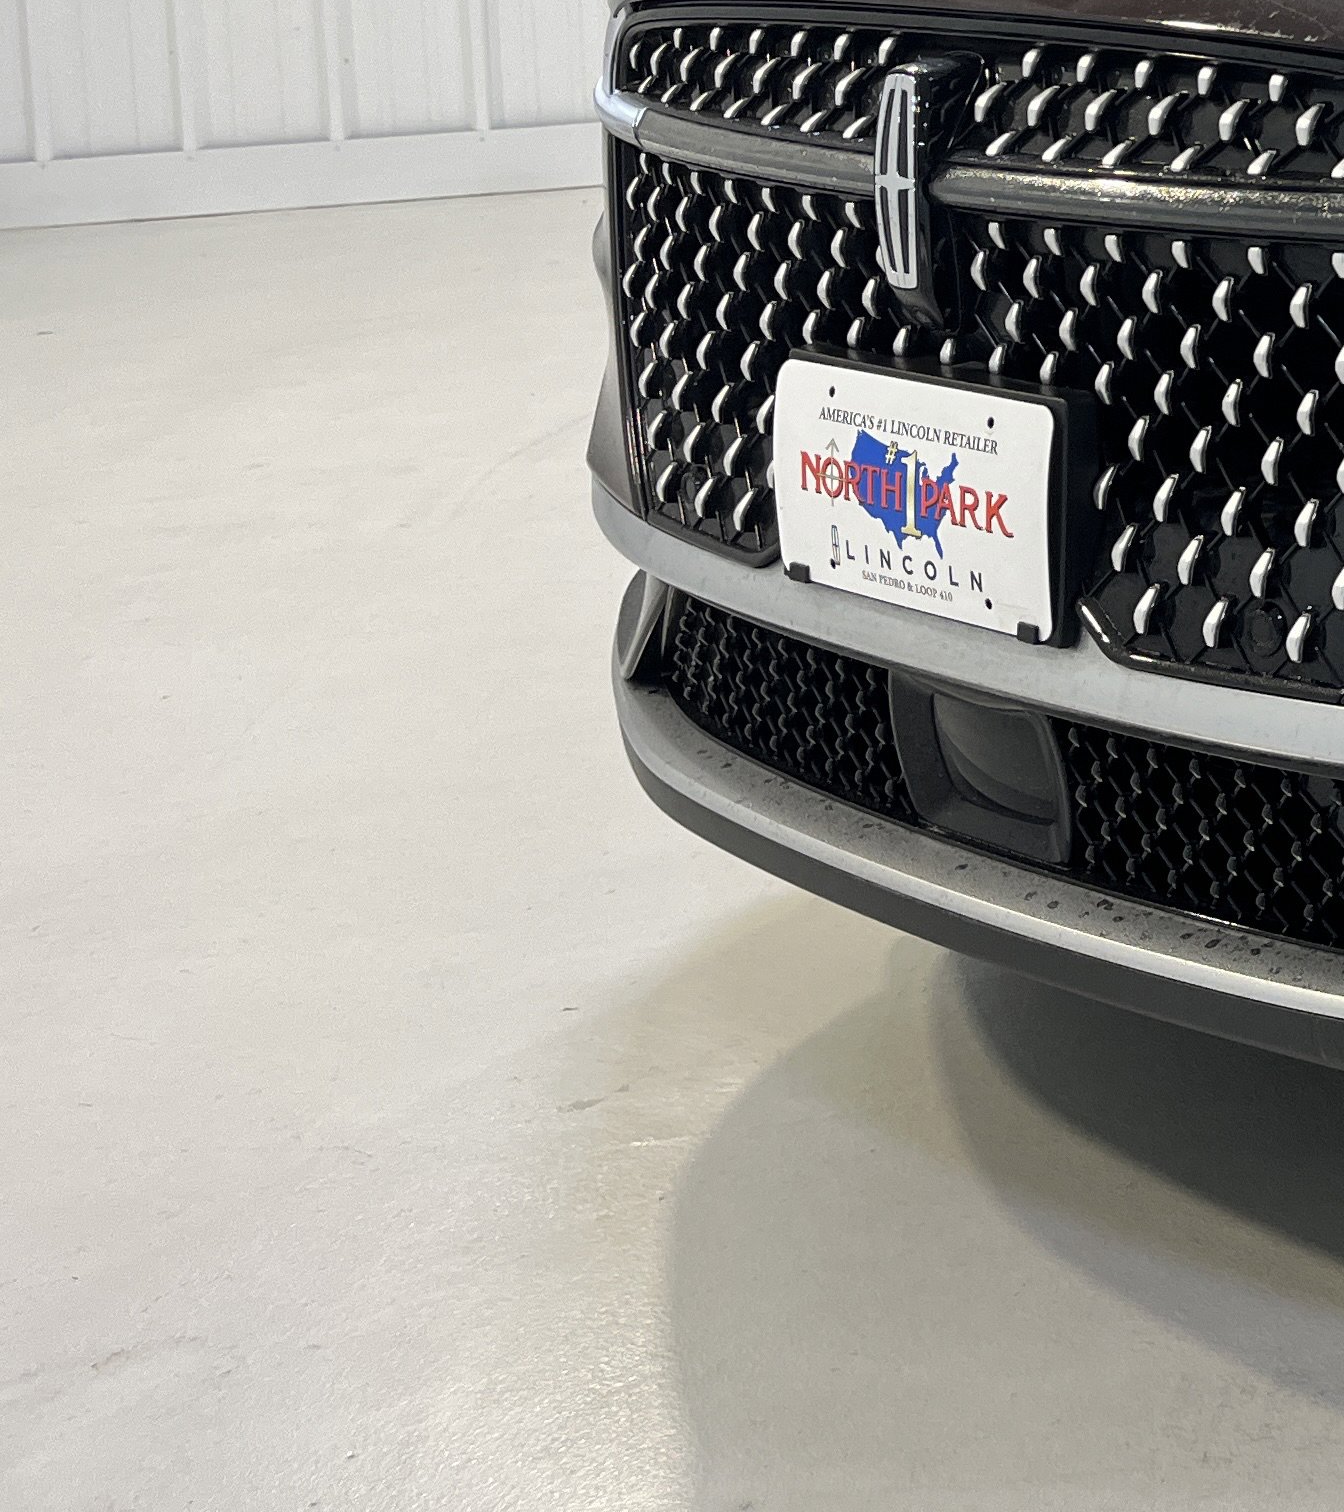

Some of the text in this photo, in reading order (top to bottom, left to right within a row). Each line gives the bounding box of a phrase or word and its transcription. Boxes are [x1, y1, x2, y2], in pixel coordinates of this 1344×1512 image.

[819, 406, 998, 456] AMERICA'S #1 LINCOLN RETAILER
[800, 450, 1014, 539] NORTH PARK
[846, 539, 983, 593] LINCOLN
[861, 569, 954, 602] SAN PEDRO & LOOP 410
